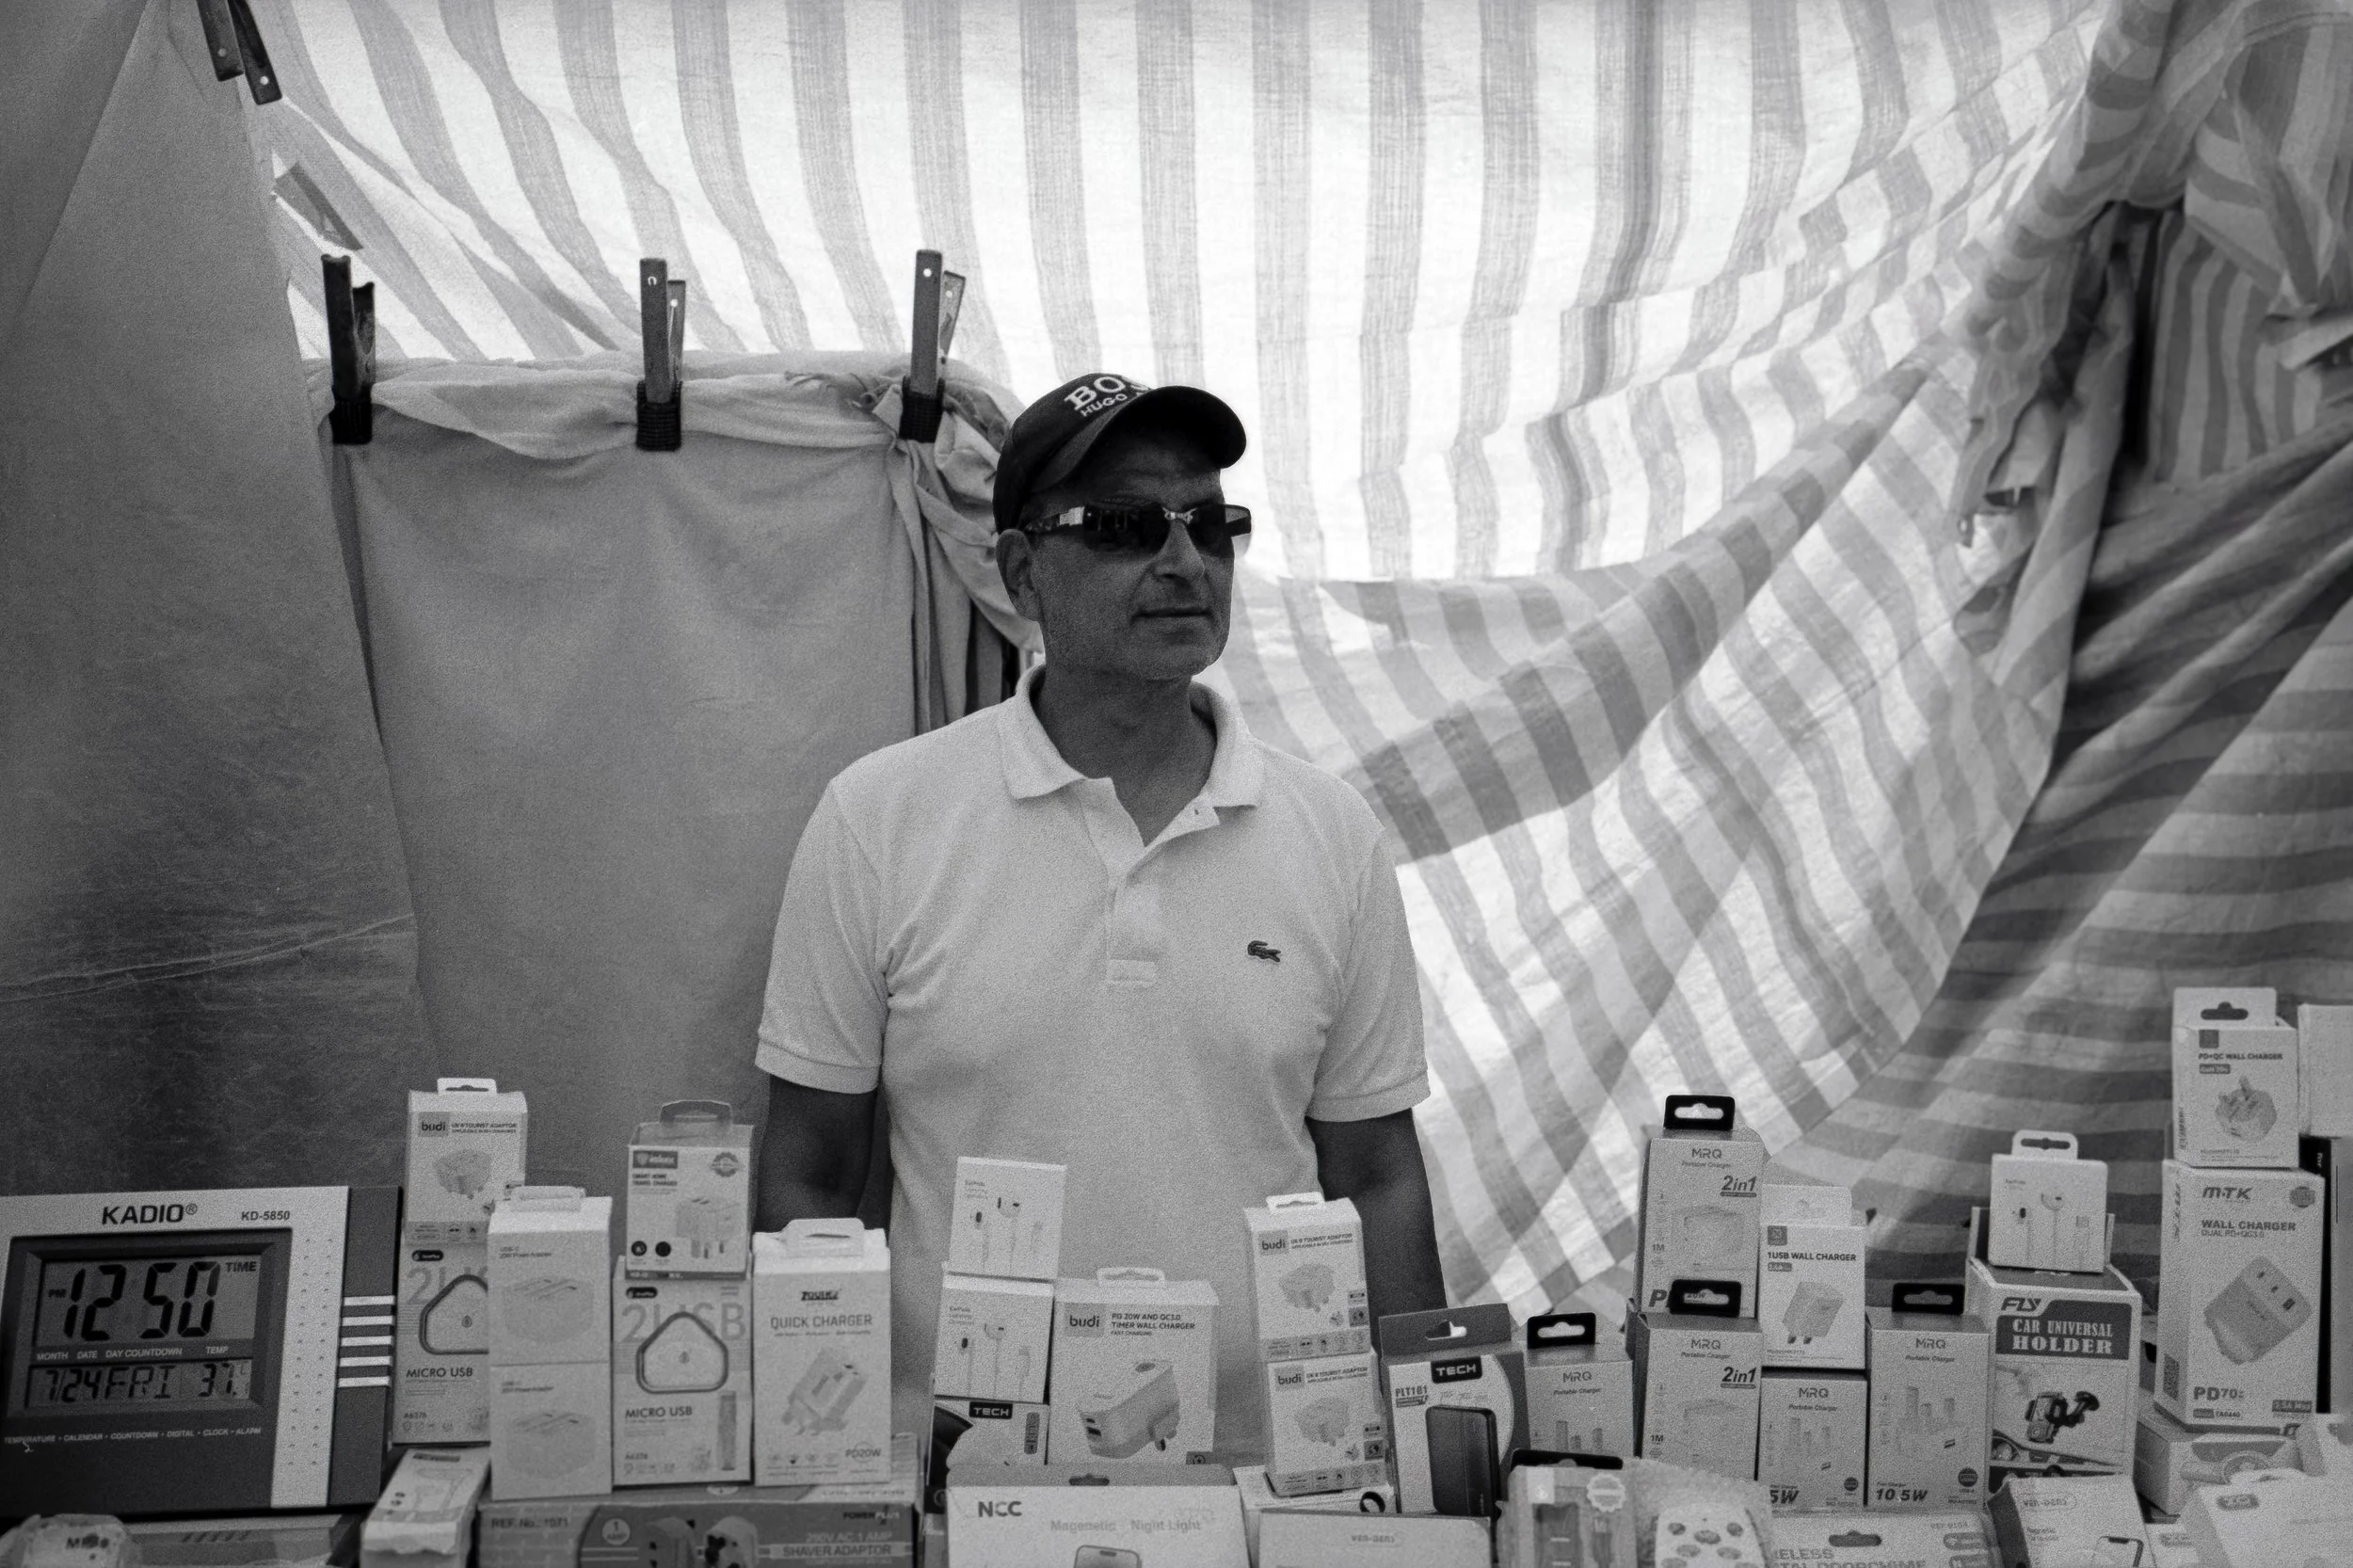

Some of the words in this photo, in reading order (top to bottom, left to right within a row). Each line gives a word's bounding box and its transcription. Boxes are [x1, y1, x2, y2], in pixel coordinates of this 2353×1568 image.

[1080, 393, 1128, 417] HUGO
[422, 1121, 446, 1131] budi
[1691, 1148, 1721, 1160] MRQ
[1721, 1176, 1757, 1192] 2in1
[241, 1209, 291, 1222] KD-5850
[2201, 1220, 2234, 1229] WALL
[2239, 1221, 2297, 1232] CHARGER
[1262, 1239, 1286, 1251] budi
[1816, 1254, 1857, 1262] CHARGER
[225, 1261, 258, 1272] TIME
[47, 1288, 67, 1298] PM
[2001, 1296, 2042, 1312] FLY
[770, 1316, 809, 1330] QUICK
[812, 1314, 873, 1327] CHARGER
[1069, 1315, 1100, 1328] budi
[1136, 1321, 1158, 1330] WALL
[2012, 1319, 2041, 1334] CAR
[2047, 1320, 2113, 1337] UNIVERSAL
[1691, 1338, 1721, 1350] MRQ
[1915, 1337, 1946, 1350] MRQ
[2011, 1335, 2113, 1355] HOLDER
[77, 1350, 98, 1360] DATE
[105, 1349, 123, 1358] DAY
[124, 1347, 183, 1358] COUNTDOWN
[205, 1345, 229, 1355] TEMP
[37, 1352, 69, 1362] MONTH
[406, 1368, 447, 1378] MICRO
[450, 1367, 473, 1377] USB
[1435, 1363, 1478, 1377] TECH
[1721, 1367, 1756, 1383] 2in1
[1278, 1373, 1302, 1385] budi
[1562, 1370, 1593, 1383] MRQ
[1799, 1386, 1829, 1399] MRQ
[625, 1407, 666, 1419] MICRO
[669, 1405, 693, 1416] USB
[973, 1407, 1010, 1416] TECH
[4, 1434, 56, 1444] TEMPERATURE
[63, 1432, 104, 1443] CALENDAR
[110, 1432, 159, 1441] COUNTDOWN
[167, 1430, 195, 1438] DIGITAL
[202, 1429, 229, 1437] CLOCK
[235, 1427, 262, 1435] ALARM
[845, 1448, 882, 1459] PD20W
[1876, 1488, 1928, 1503] 105W
[978, 1500, 1023, 1518] NCC
[614, 1520, 619, 1532] 1
[865, 1530, 893, 1542] AMP
[783, 1546, 832, 1558] SHAVER
[834, 1544, 892, 1556] ADAPTOR
[1774, 1548, 1834, 1560] ELESS
